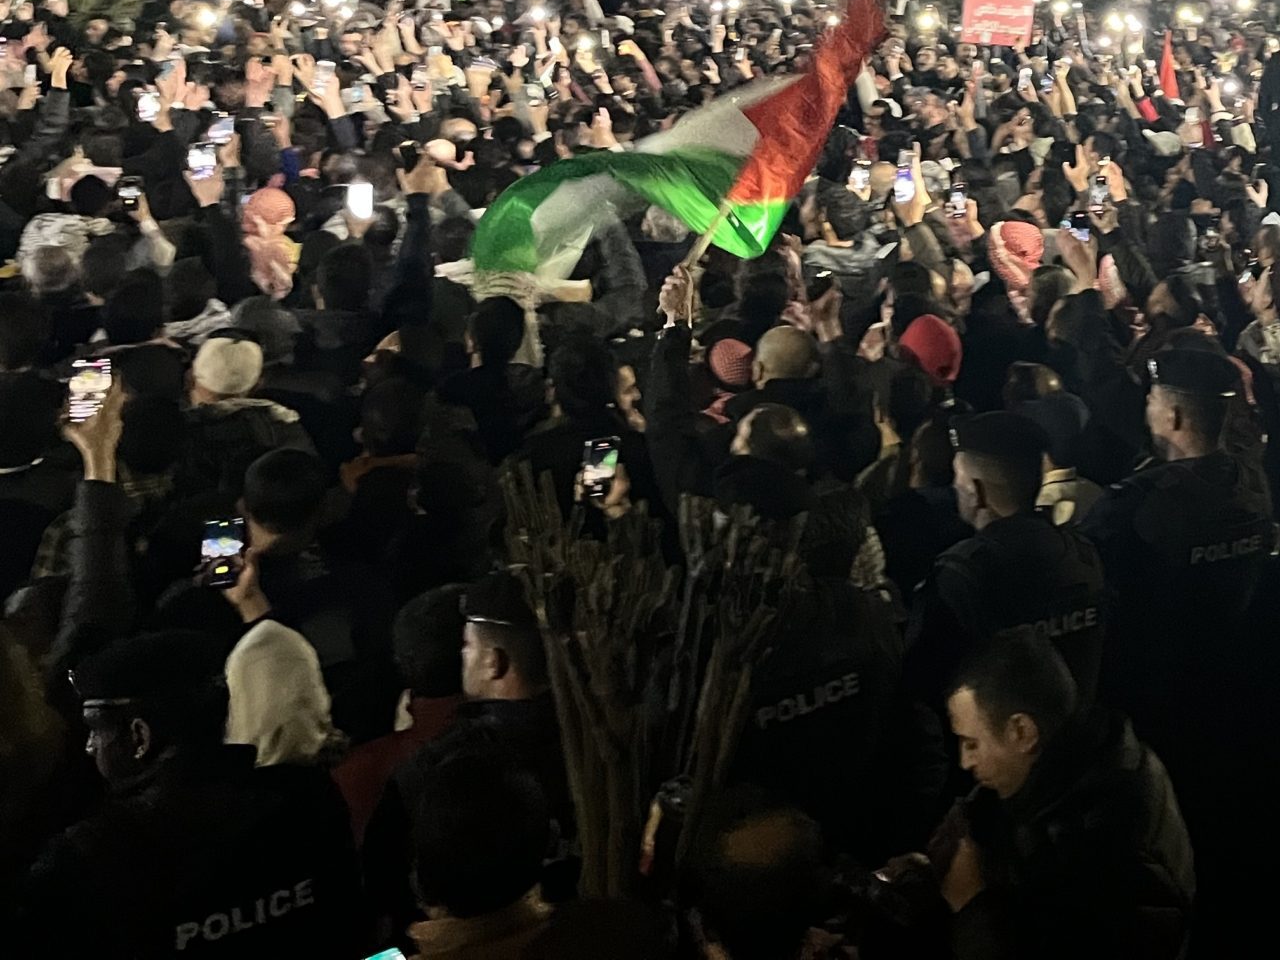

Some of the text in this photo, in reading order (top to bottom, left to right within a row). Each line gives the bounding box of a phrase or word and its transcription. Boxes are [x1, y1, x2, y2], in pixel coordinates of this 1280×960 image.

[1190, 533, 1263, 565] POLICE
[754, 671, 861, 730] POLICE
[173, 877, 316, 951] POLICE
